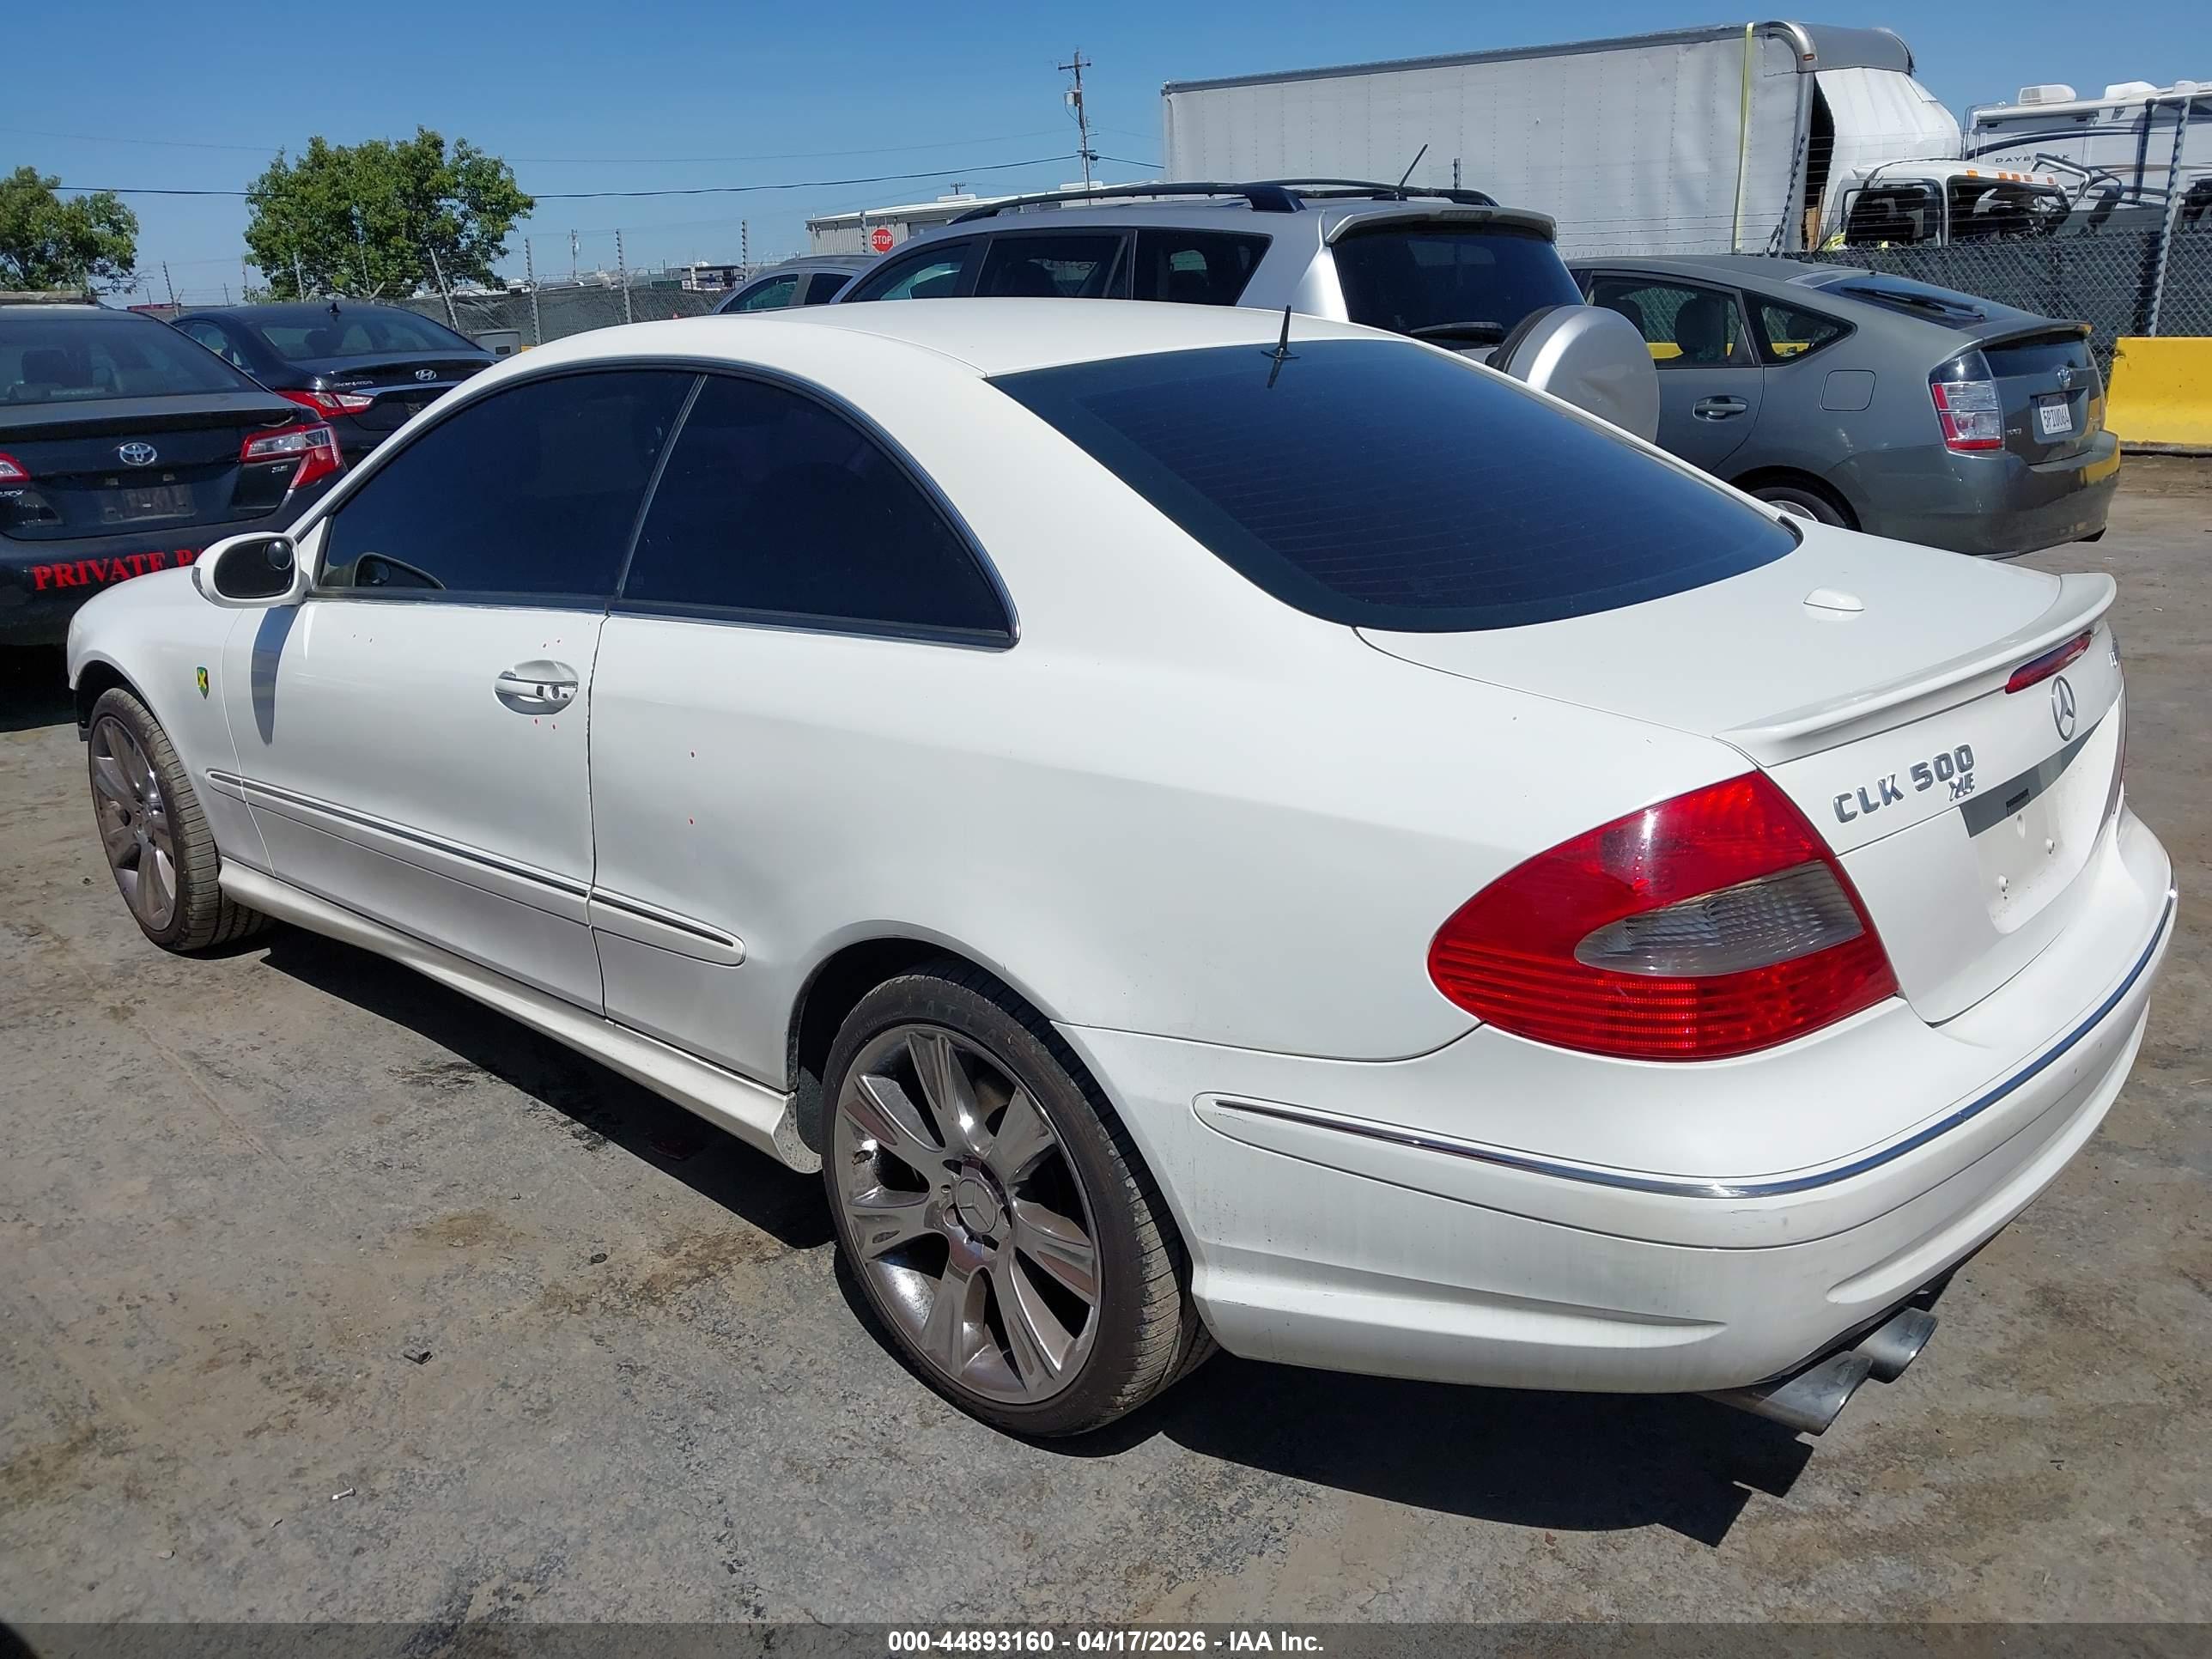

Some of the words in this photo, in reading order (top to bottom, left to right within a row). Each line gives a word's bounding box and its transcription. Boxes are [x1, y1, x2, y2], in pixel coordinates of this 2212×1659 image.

[872, 235, 892, 245] STOP
[32, 551, 166, 590] PRIVATE
[1833, 773, 1905, 823] CLK
[1909, 744, 1975, 792] 500
